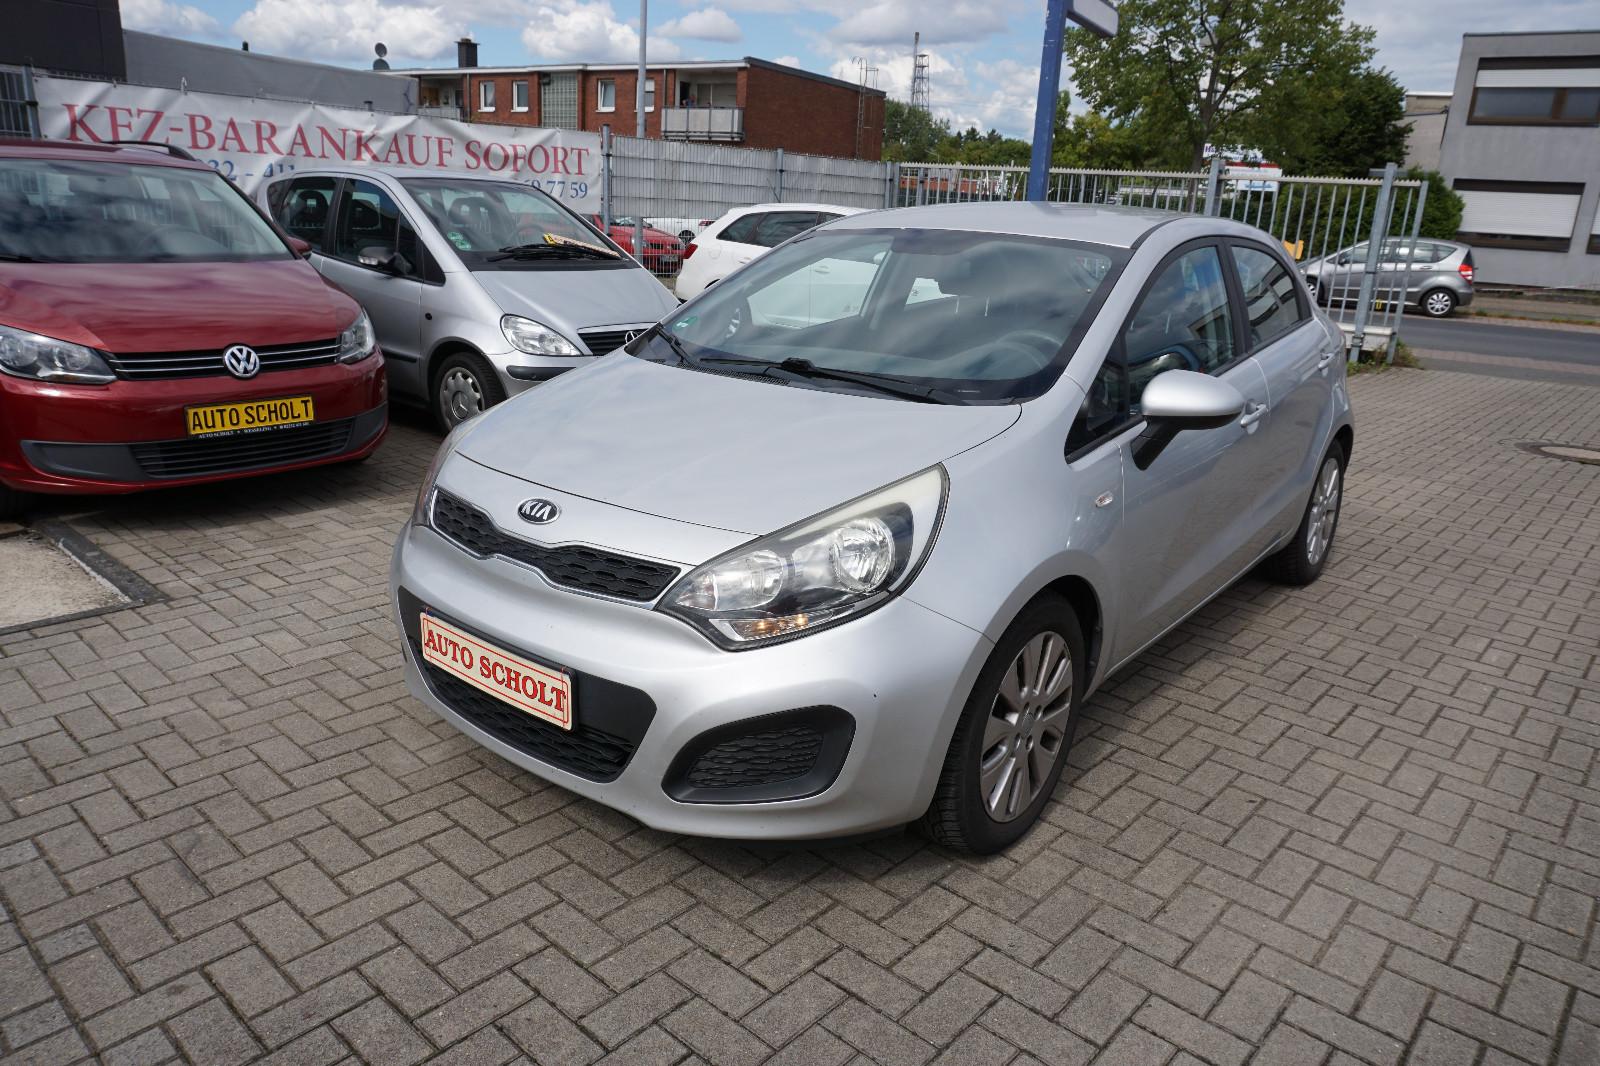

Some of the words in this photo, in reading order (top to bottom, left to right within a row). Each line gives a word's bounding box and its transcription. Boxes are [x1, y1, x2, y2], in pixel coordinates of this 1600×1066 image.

[61, 103, 454, 168] KFZ-BARANKAUF
[464, 140, 589, 175] SOFORT
[570, 182, 588, 199] 59
[192, 408, 240, 431] AUTO
[243, 399, 311, 425] SCHOLT
[520, 500, 552, 521] KIA
[424, 629, 474, 670] AUTO
[479, 655, 566, 712] SCHOLT
